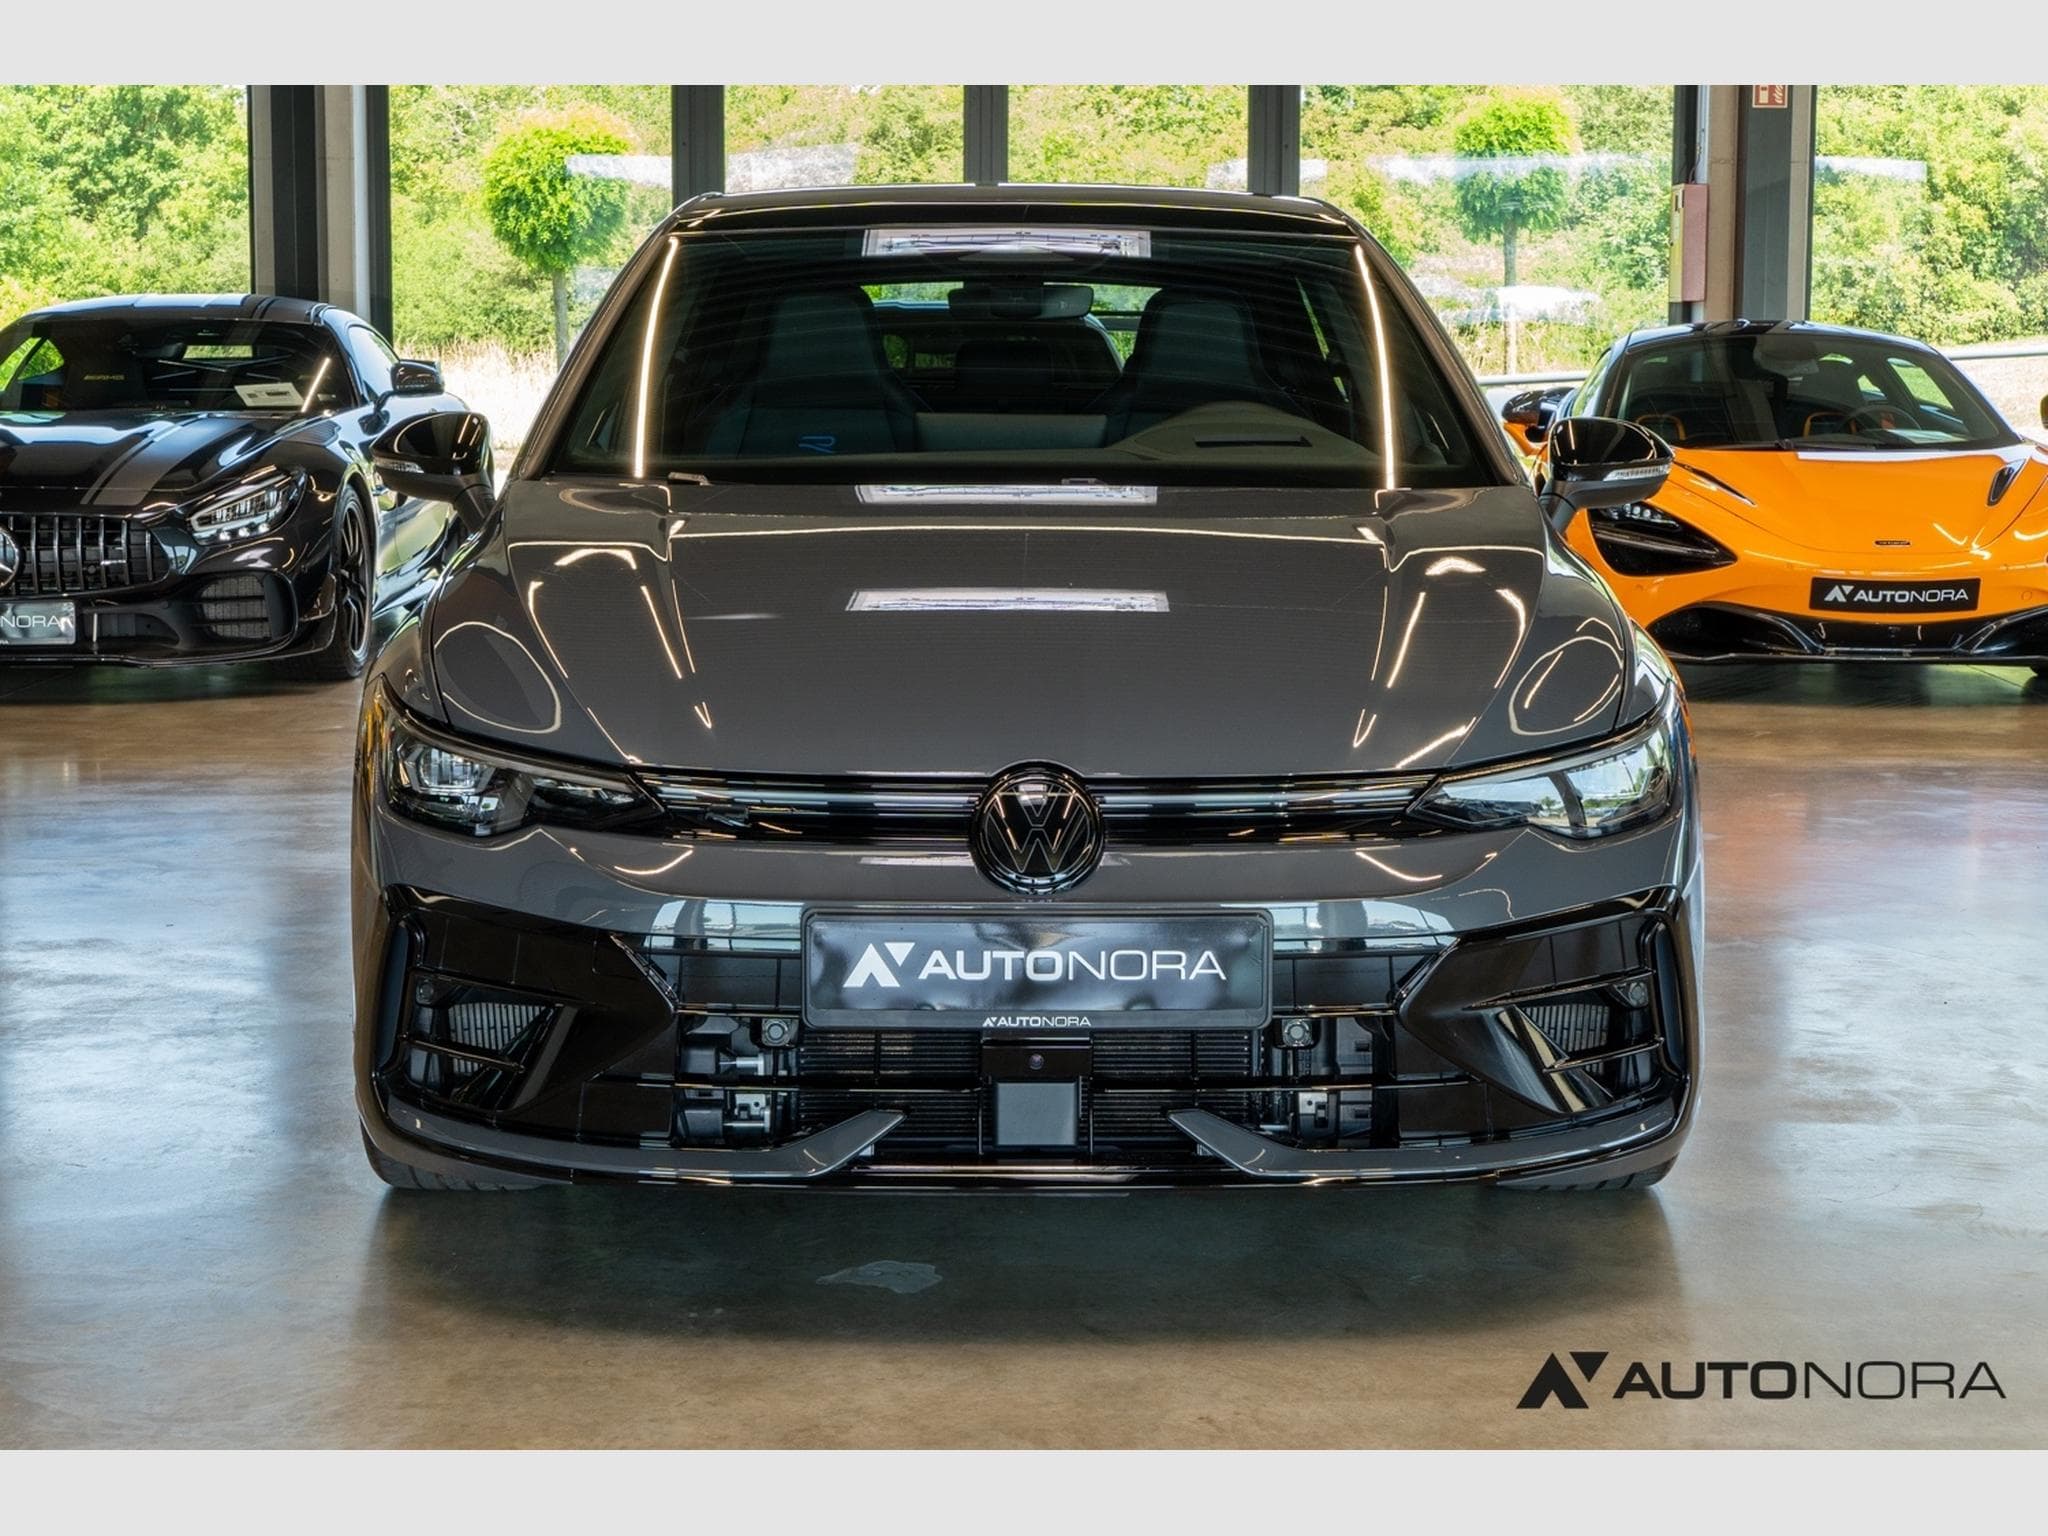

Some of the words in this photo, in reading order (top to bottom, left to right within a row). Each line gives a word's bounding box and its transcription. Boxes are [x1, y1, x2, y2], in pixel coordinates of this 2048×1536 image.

[1853, 588, 1969, 603] AUTONORA
[918, 949, 1227, 982] AUTONORA
[996, 1016, 1092, 1028] AUTONORA
